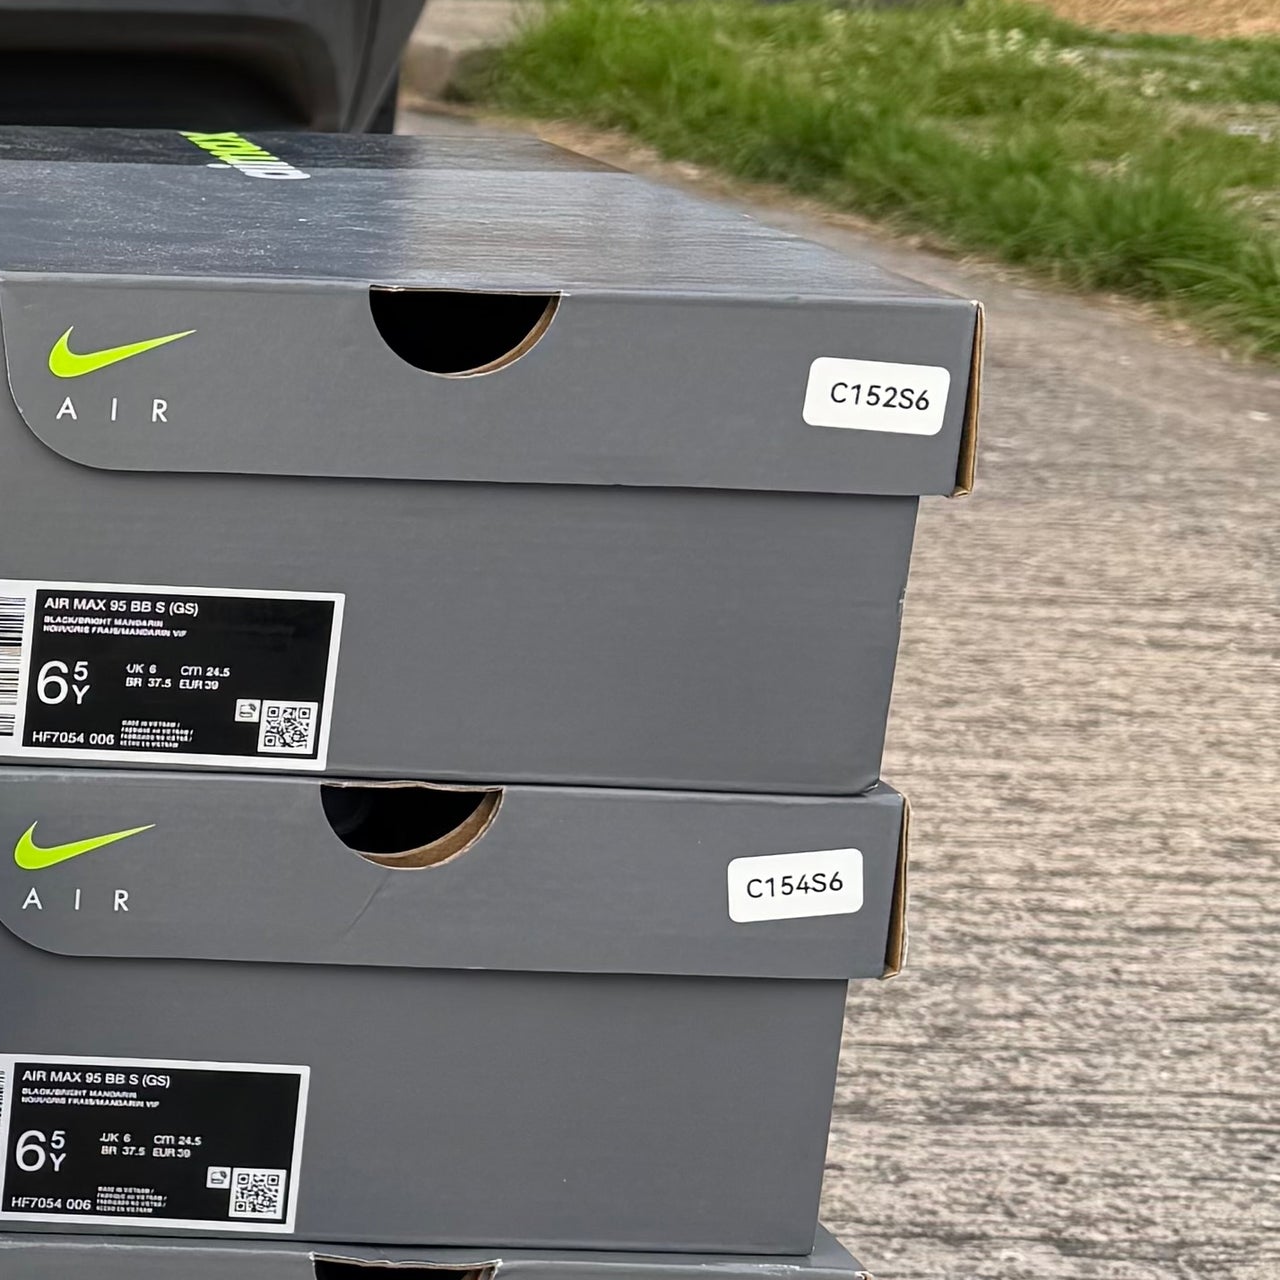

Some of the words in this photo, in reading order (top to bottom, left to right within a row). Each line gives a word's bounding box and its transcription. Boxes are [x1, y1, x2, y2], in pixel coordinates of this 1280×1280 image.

[830, 382, 930, 411] C152S6
[55, 396, 168, 423] AIR
[44, 598, 69, 609] AIR
[73, 598, 106, 610] MAX
[110, 600, 127, 611] 95
[131, 601, 151, 612] BB
[155, 602, 165, 613] S
[169, 602, 199, 617] (GS)
[73, 661, 89, 681] 5
[126, 664, 144, 674] UK
[149, 664, 157, 674] 6
[181, 666, 202, 676] cm
[206, 667, 230, 677] 24.5
[37, 660, 69, 704] 6
[126, 677, 142, 687] BR
[147, 678, 171, 688] 37.5
[179, 679, 202, 690] EUR
[205, 680, 219, 690] 39
[72, 685, 90, 705] Y
[32, 731, 84, 743] HF7054
[89, 733, 115, 745] 006
[746, 871, 843, 899] C154S6
[22, 887, 129, 912] AIR
[22, 1071, 46, 1082] AIR
[50, 1072, 82, 1083] MAX
[85, 1073, 101, 1084] 95
[105, 1073, 125, 1084] BB
[129, 1074, 139, 1085] S
[142, 1074, 170, 1088] (GS)
[51, 1130, 66, 1149] 5
[16, 1130, 46, 1172] 6
[49, 1153, 66, 1172] Y
[12, 1197, 62, 1209] HF7054
[66, 1199, 91, 1210] 006
